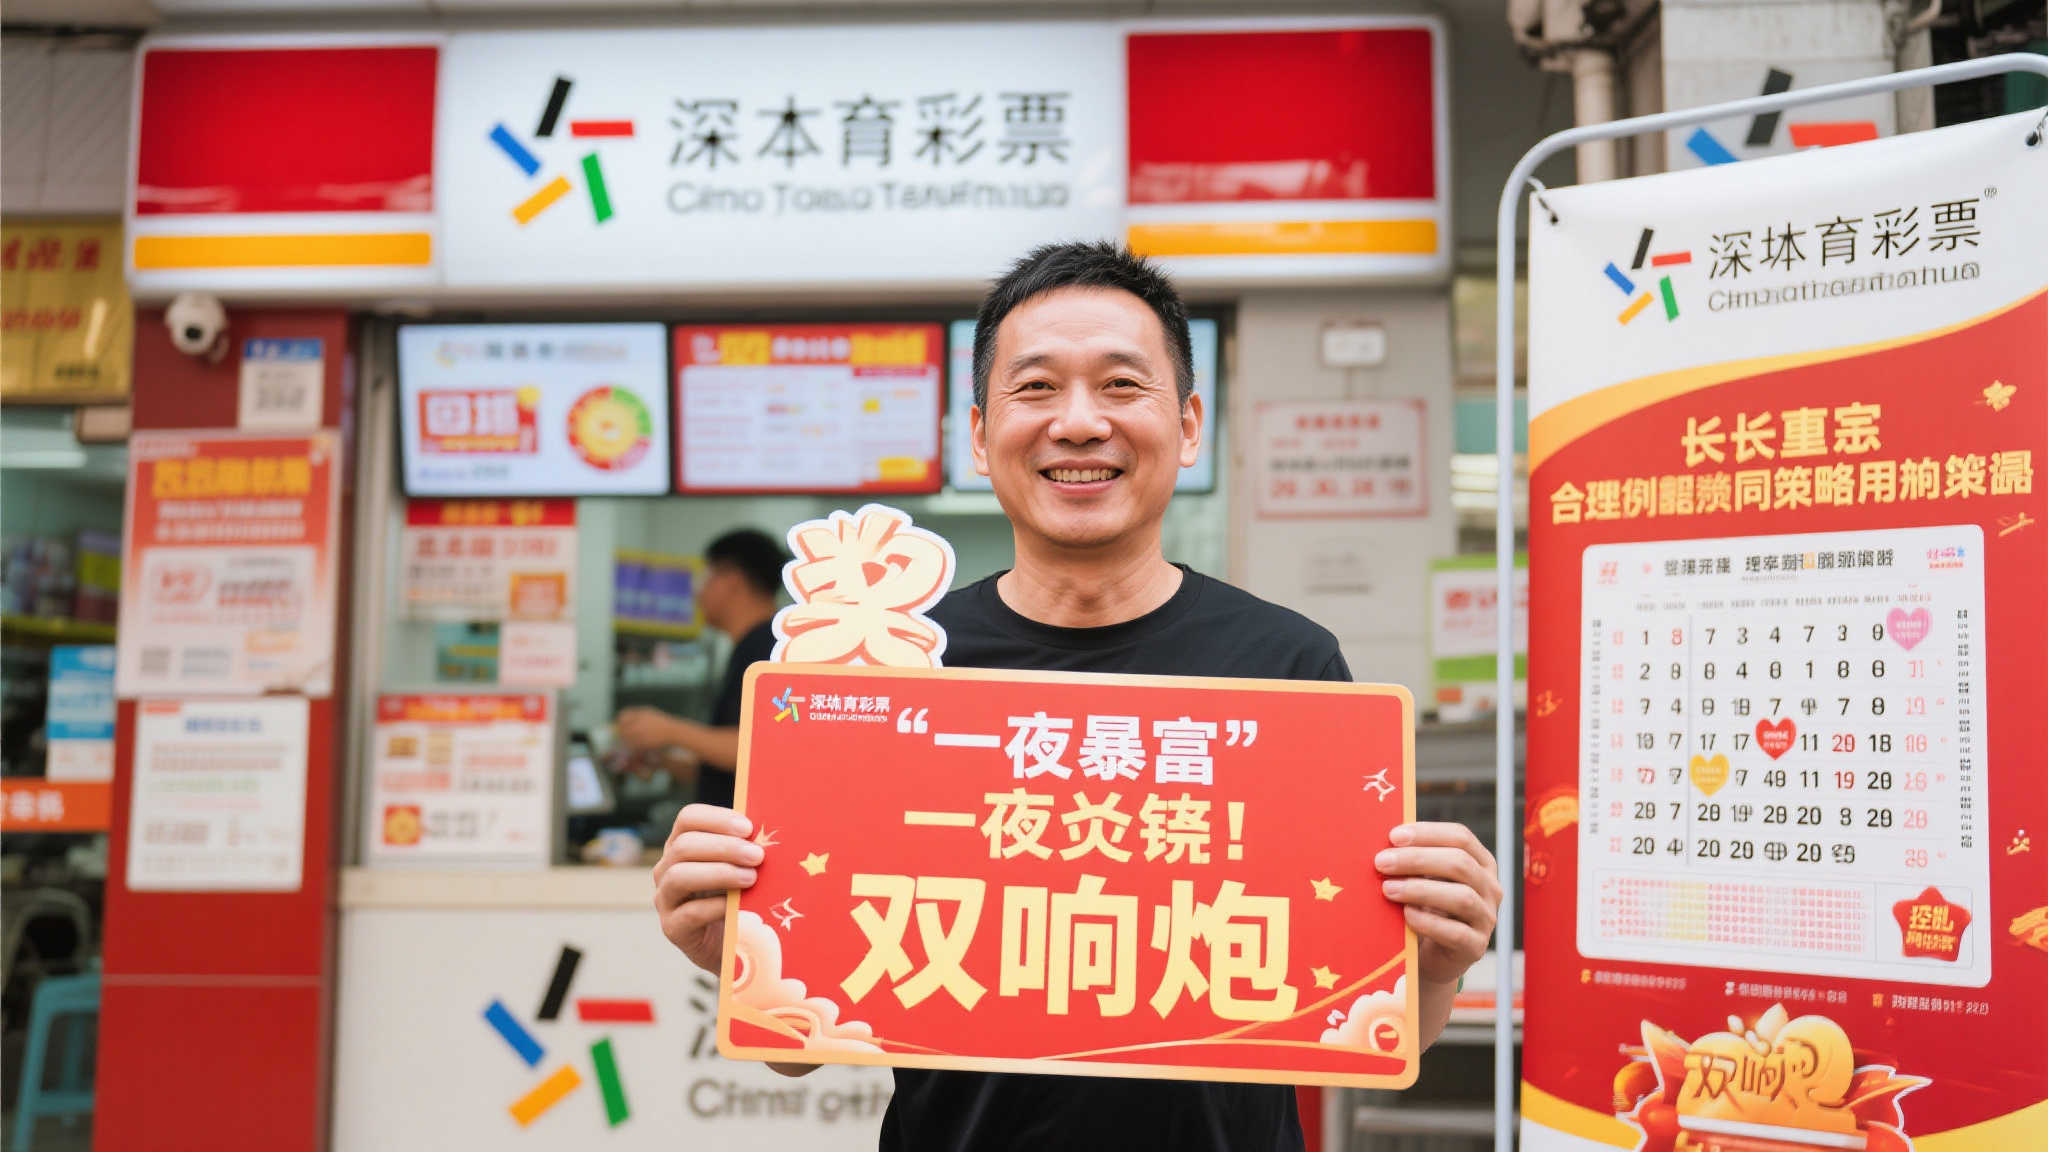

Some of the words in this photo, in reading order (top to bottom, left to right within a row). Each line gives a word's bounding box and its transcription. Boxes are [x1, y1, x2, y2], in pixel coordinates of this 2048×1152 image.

[1769, 626, 1781, 645] 4
[1803, 625, 1815, 643] 7
[1640, 663, 1650, 680] 2
[1736, 662, 1748, 679] 4
[1769, 698, 1782, 716] 7
[1838, 698, 1850, 716] 7
[896, 707, 1259, 786] “一夜暴富”
[1800, 734, 1819, 752] 11
[1800, 771, 1819, 788] 11
[1670, 803, 1681, 820] 7
[1797, 806, 1822, 825] 20
[1632, 837, 1655, 855] 20
[1697, 839, 1721, 858] 20
[1797, 843, 1822, 863] 20
[838, 872, 1299, 1023] 双响炮
